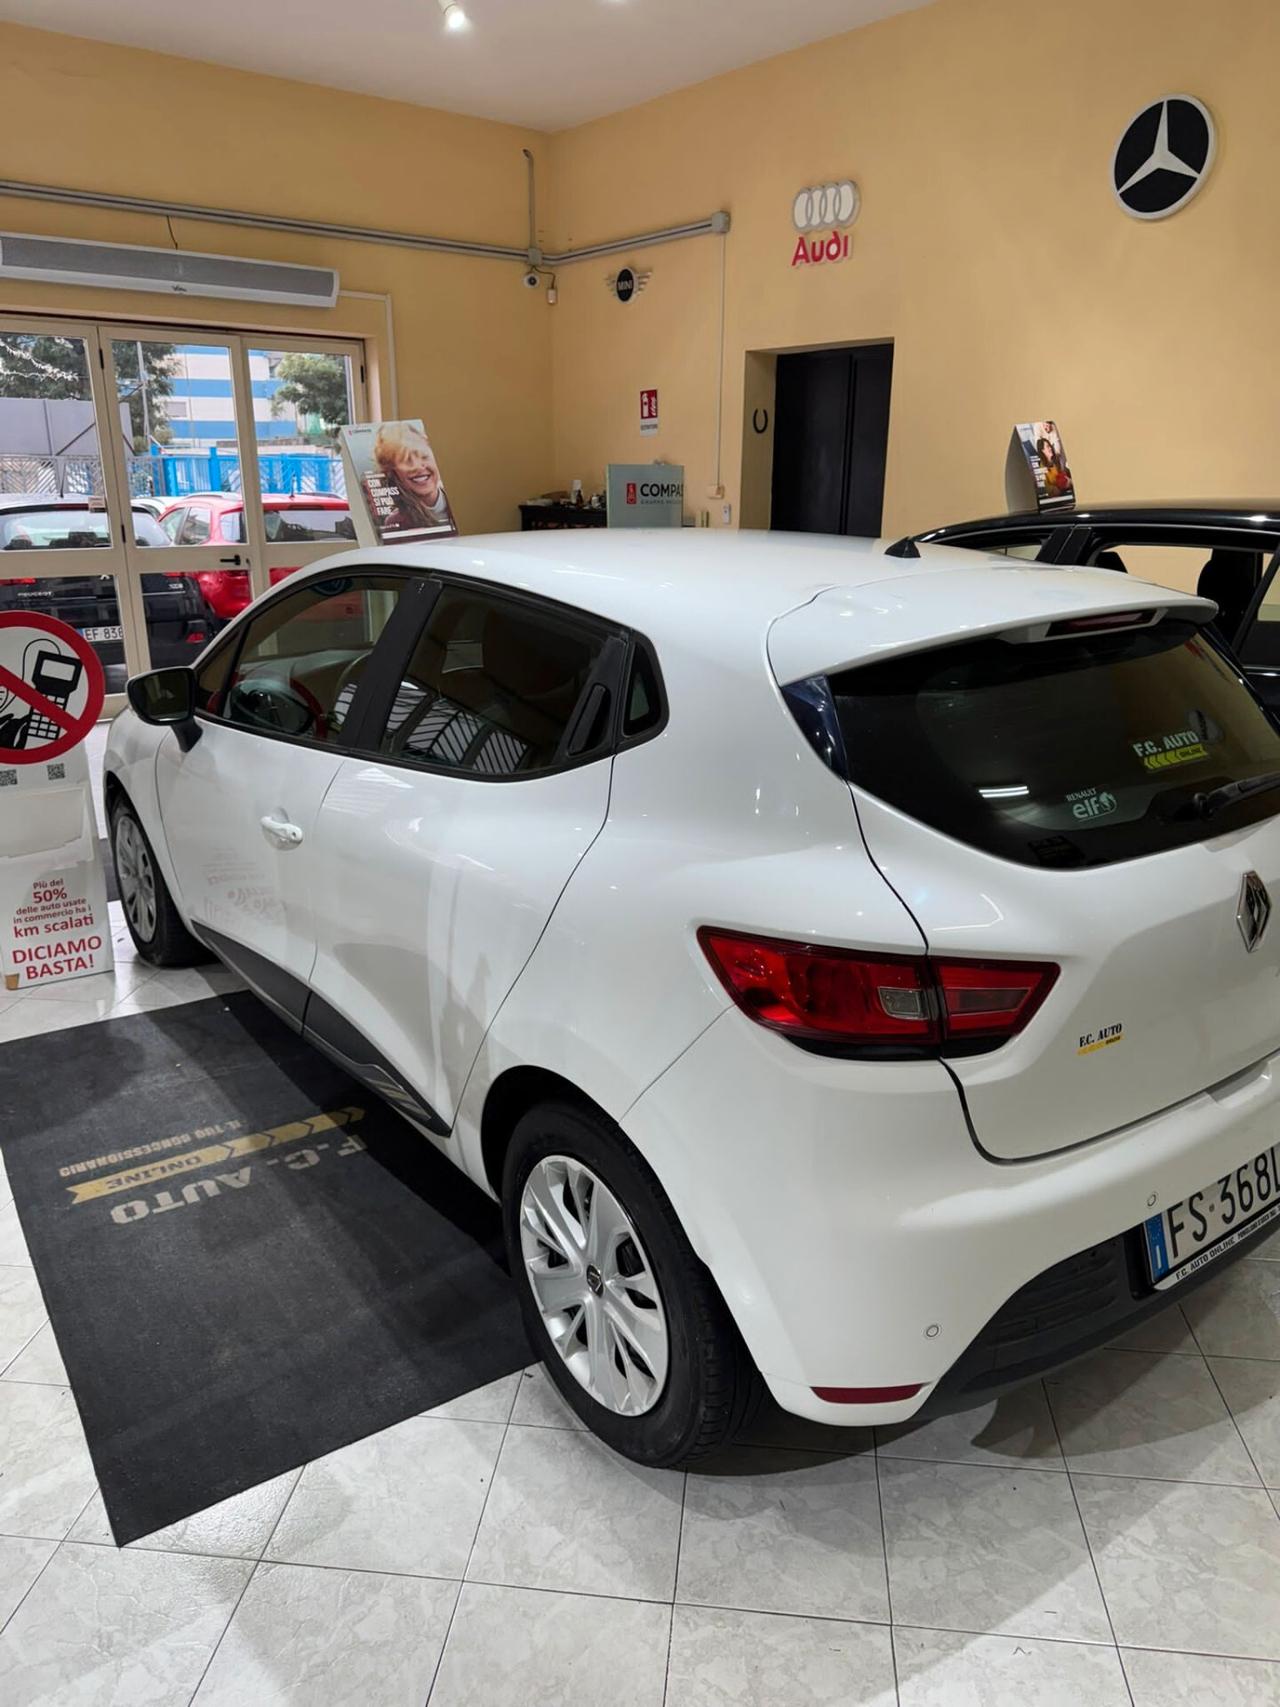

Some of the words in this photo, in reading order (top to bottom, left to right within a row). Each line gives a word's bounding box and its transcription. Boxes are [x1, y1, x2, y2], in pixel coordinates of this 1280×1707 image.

[791, 230, 848, 266] Audi
[1133, 740, 1162, 757] F.C.
[1163, 730, 1199, 749] AUTO
[1066, 788, 1097, 801] RENAULT
[1072, 797, 1101, 819] elf
[49, 878, 64, 887] del
[16, 906, 38, 915] delle
[40, 902, 61, 911] auto
[63, 898, 86, 908] usate
[33, 887, 67, 904] 50%
[14, 926, 39, 938] km
[44, 913, 94, 933] scalati
[24, 909, 74, 922] commercio
[12, 935, 102, 964] DICIAMO
[26, 954, 94, 980] BASTA!
[1097, 1023, 1122, 1040] AUTO
[195, 1123, 223, 1139] TUO
[58, 1132, 191, 1177] CONCESSIONARIO
[106, 1155, 201, 1190] ONLINE
[110, 1166, 252, 1224] AUTO
[1167, 1191, 1207, 1259] FS
[1190, 1253, 1209, 1271] AUTO
[1209, 1237, 1235, 1257] ONLINE
